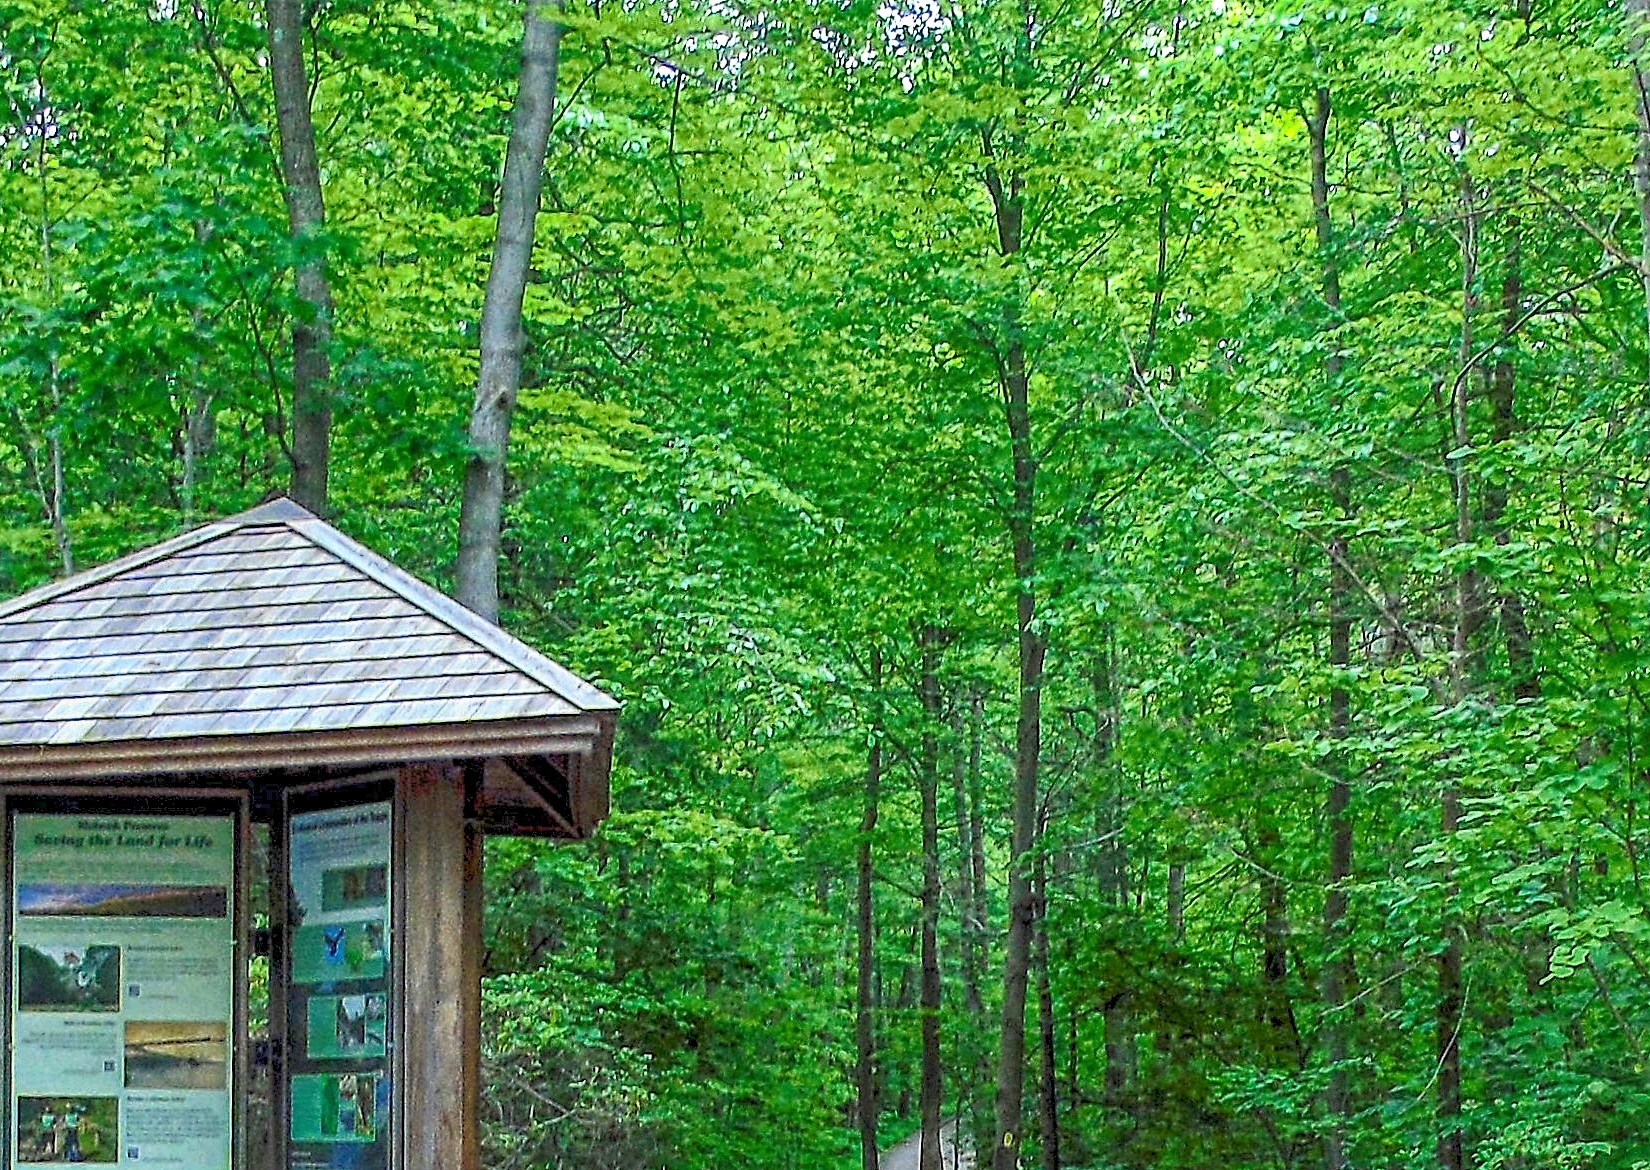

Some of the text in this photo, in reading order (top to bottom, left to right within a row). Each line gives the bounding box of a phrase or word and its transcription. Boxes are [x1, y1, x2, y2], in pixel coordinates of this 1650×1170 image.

[88, 834, 113, 846] the
[117, 834, 154, 846] Land
[158, 834, 181, 848] for
[185, 834, 213, 848] Life
